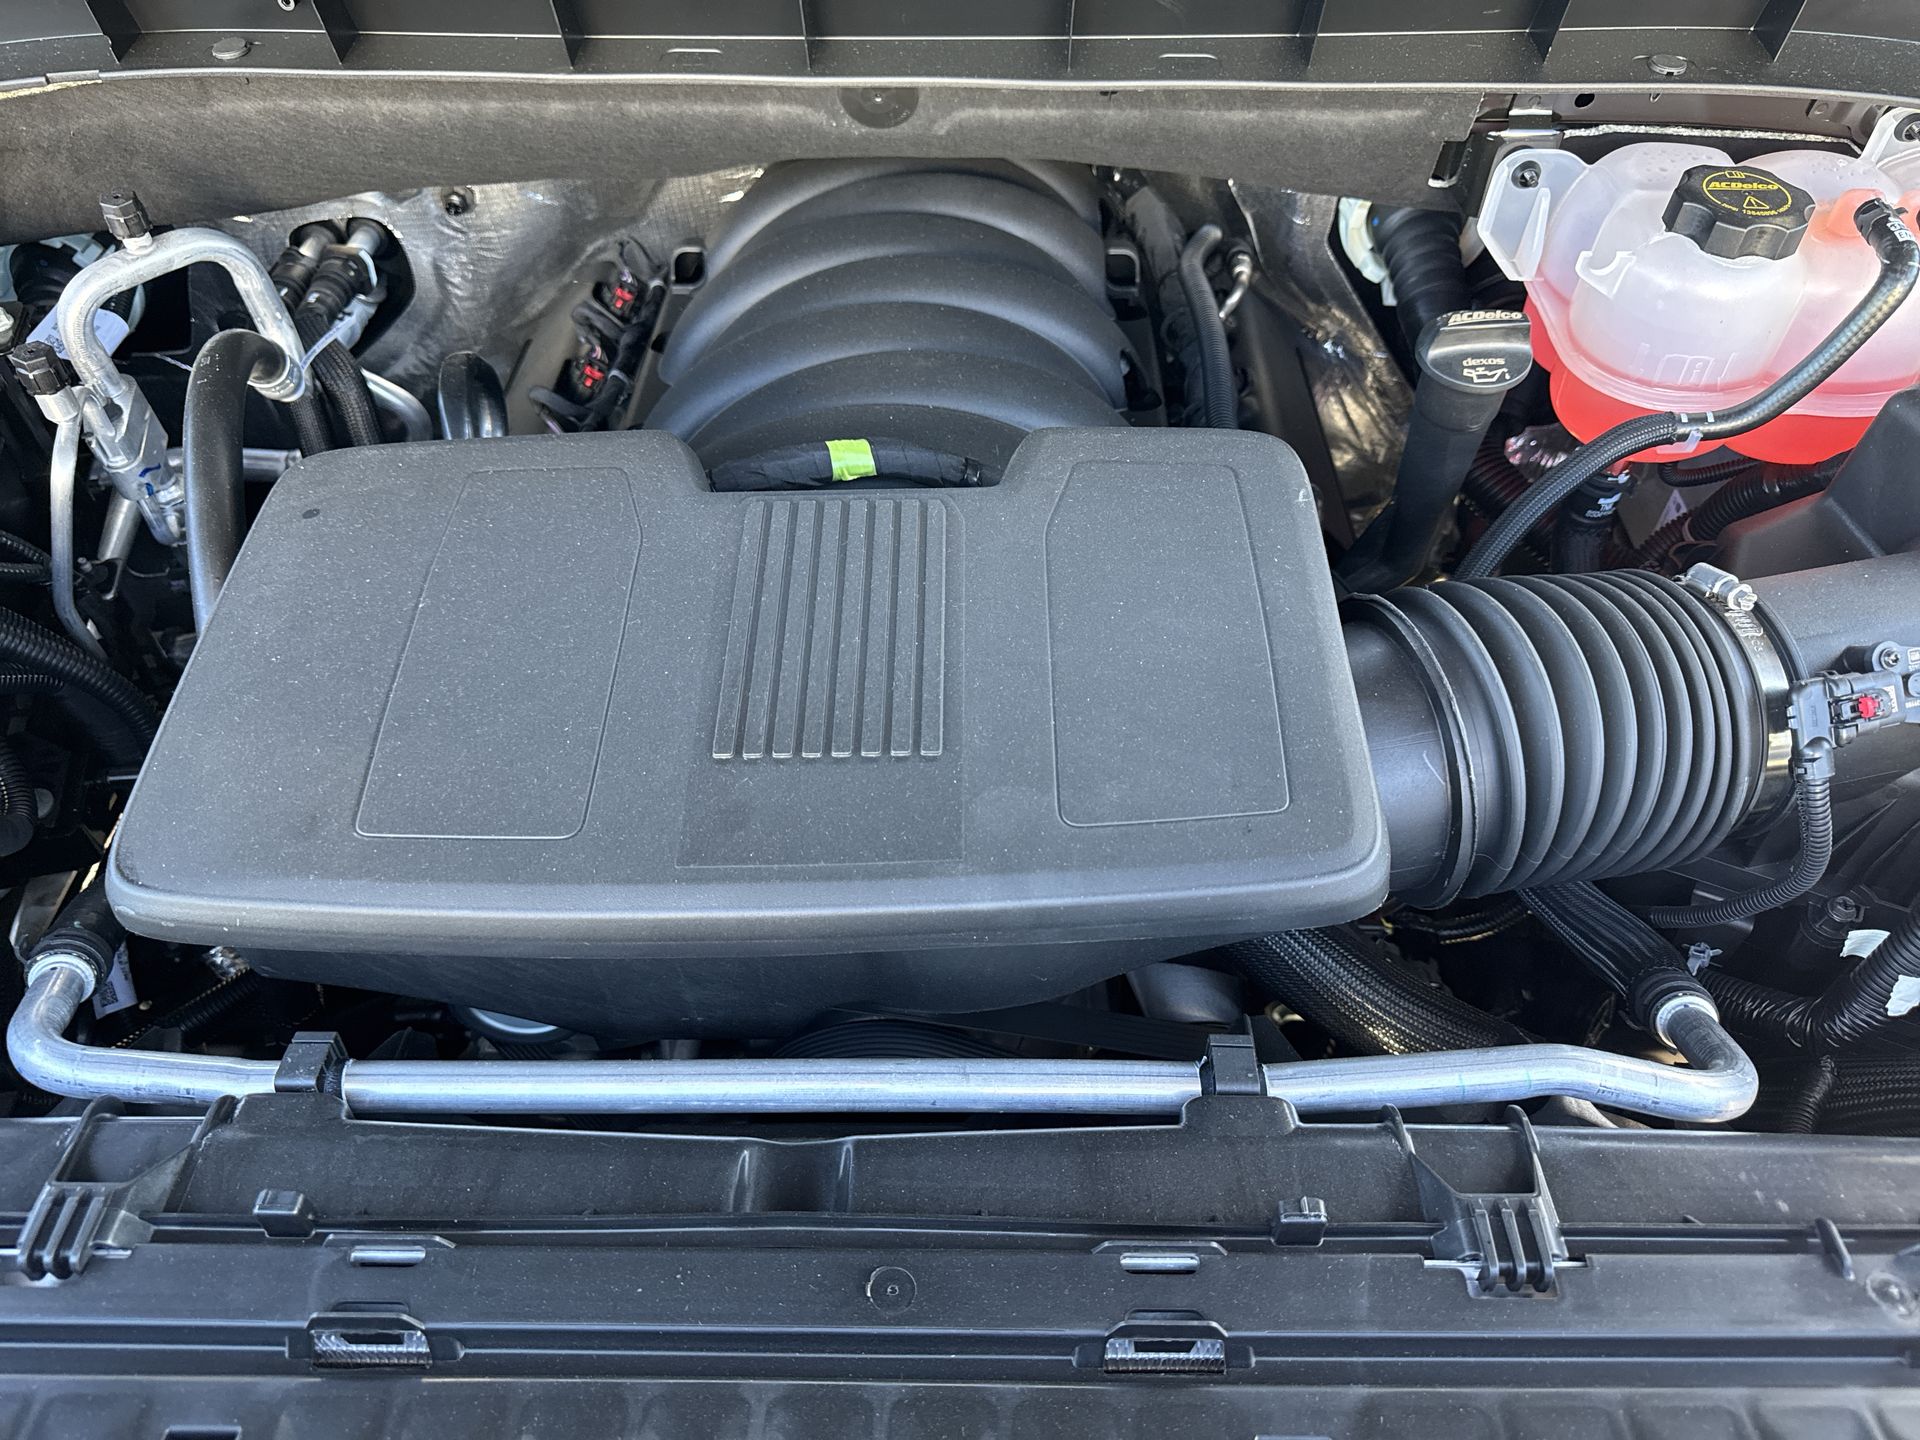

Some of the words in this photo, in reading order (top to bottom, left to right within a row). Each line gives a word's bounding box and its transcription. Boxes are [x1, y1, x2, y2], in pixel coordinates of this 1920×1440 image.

[1708, 181, 1779, 190] ACDelco
[1448, 310, 1522, 323] ACDelco
[1462, 357, 1505, 366] dexos
